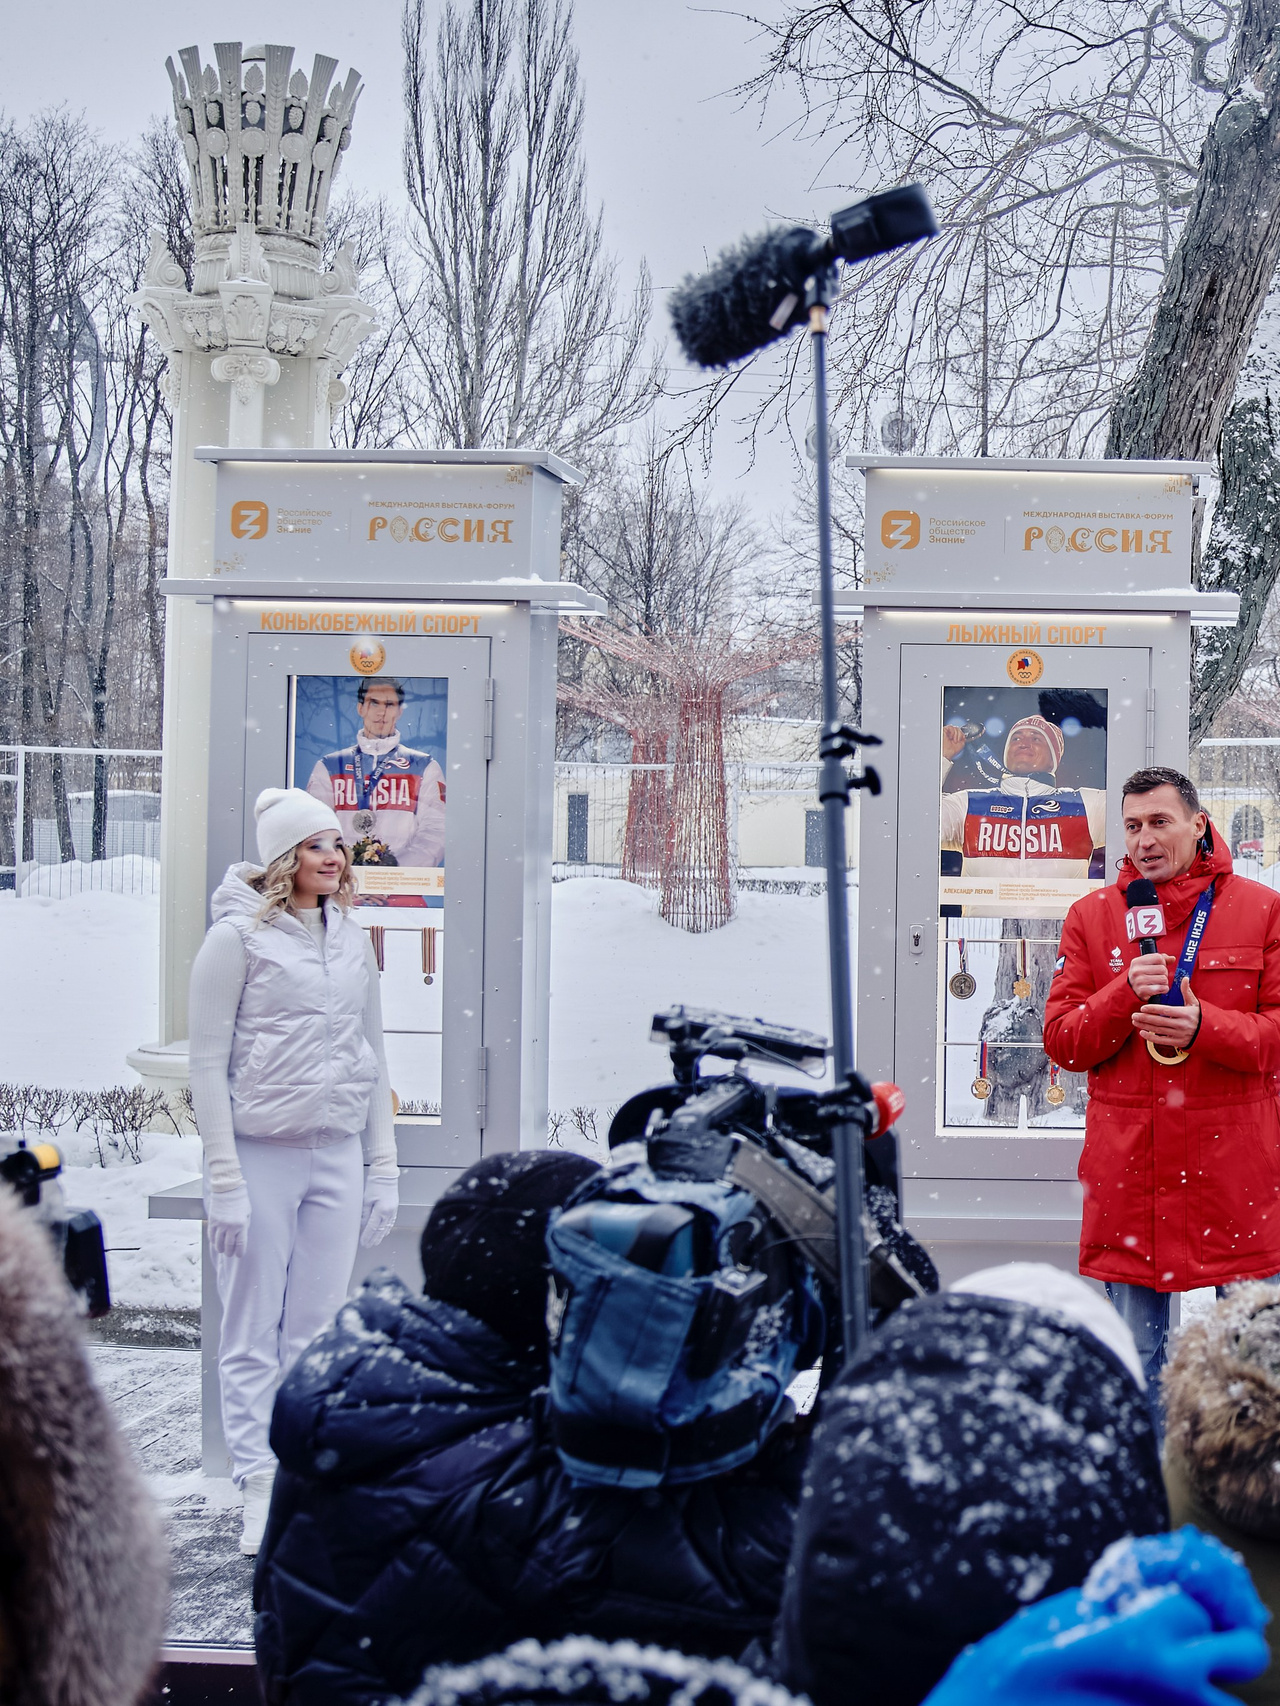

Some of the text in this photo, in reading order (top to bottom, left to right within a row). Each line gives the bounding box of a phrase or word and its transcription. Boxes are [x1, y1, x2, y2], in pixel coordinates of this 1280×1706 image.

[368, 501, 515, 510] МЕЖДУНАРОДНАЯ ВЫСТАВКА-ФОРУМ
[1023, 511, 1173, 520] МЕЖДУНАРОДНАЯ ВЫСТАВКА-ФОРУМ
[366, 515, 514, 543] РОССИЯ
[929, 517, 986, 527] Российское
[929, 527, 976, 536] общество
[929, 535, 966, 544] Знание
[1022, 525, 1173, 553] РОССИЯ
[261, 609, 482, 634] КОНЬКОБЕЖНЫЙ СПОРТ
[946, 621, 1107, 645] ЛЫЖНЫЙ СПОРТ
[334, 778, 411, 807] RUSIA
[978, 822, 1063, 853] RUSSIA
[1183, 909, 1207, 962] SOCHI 2014
